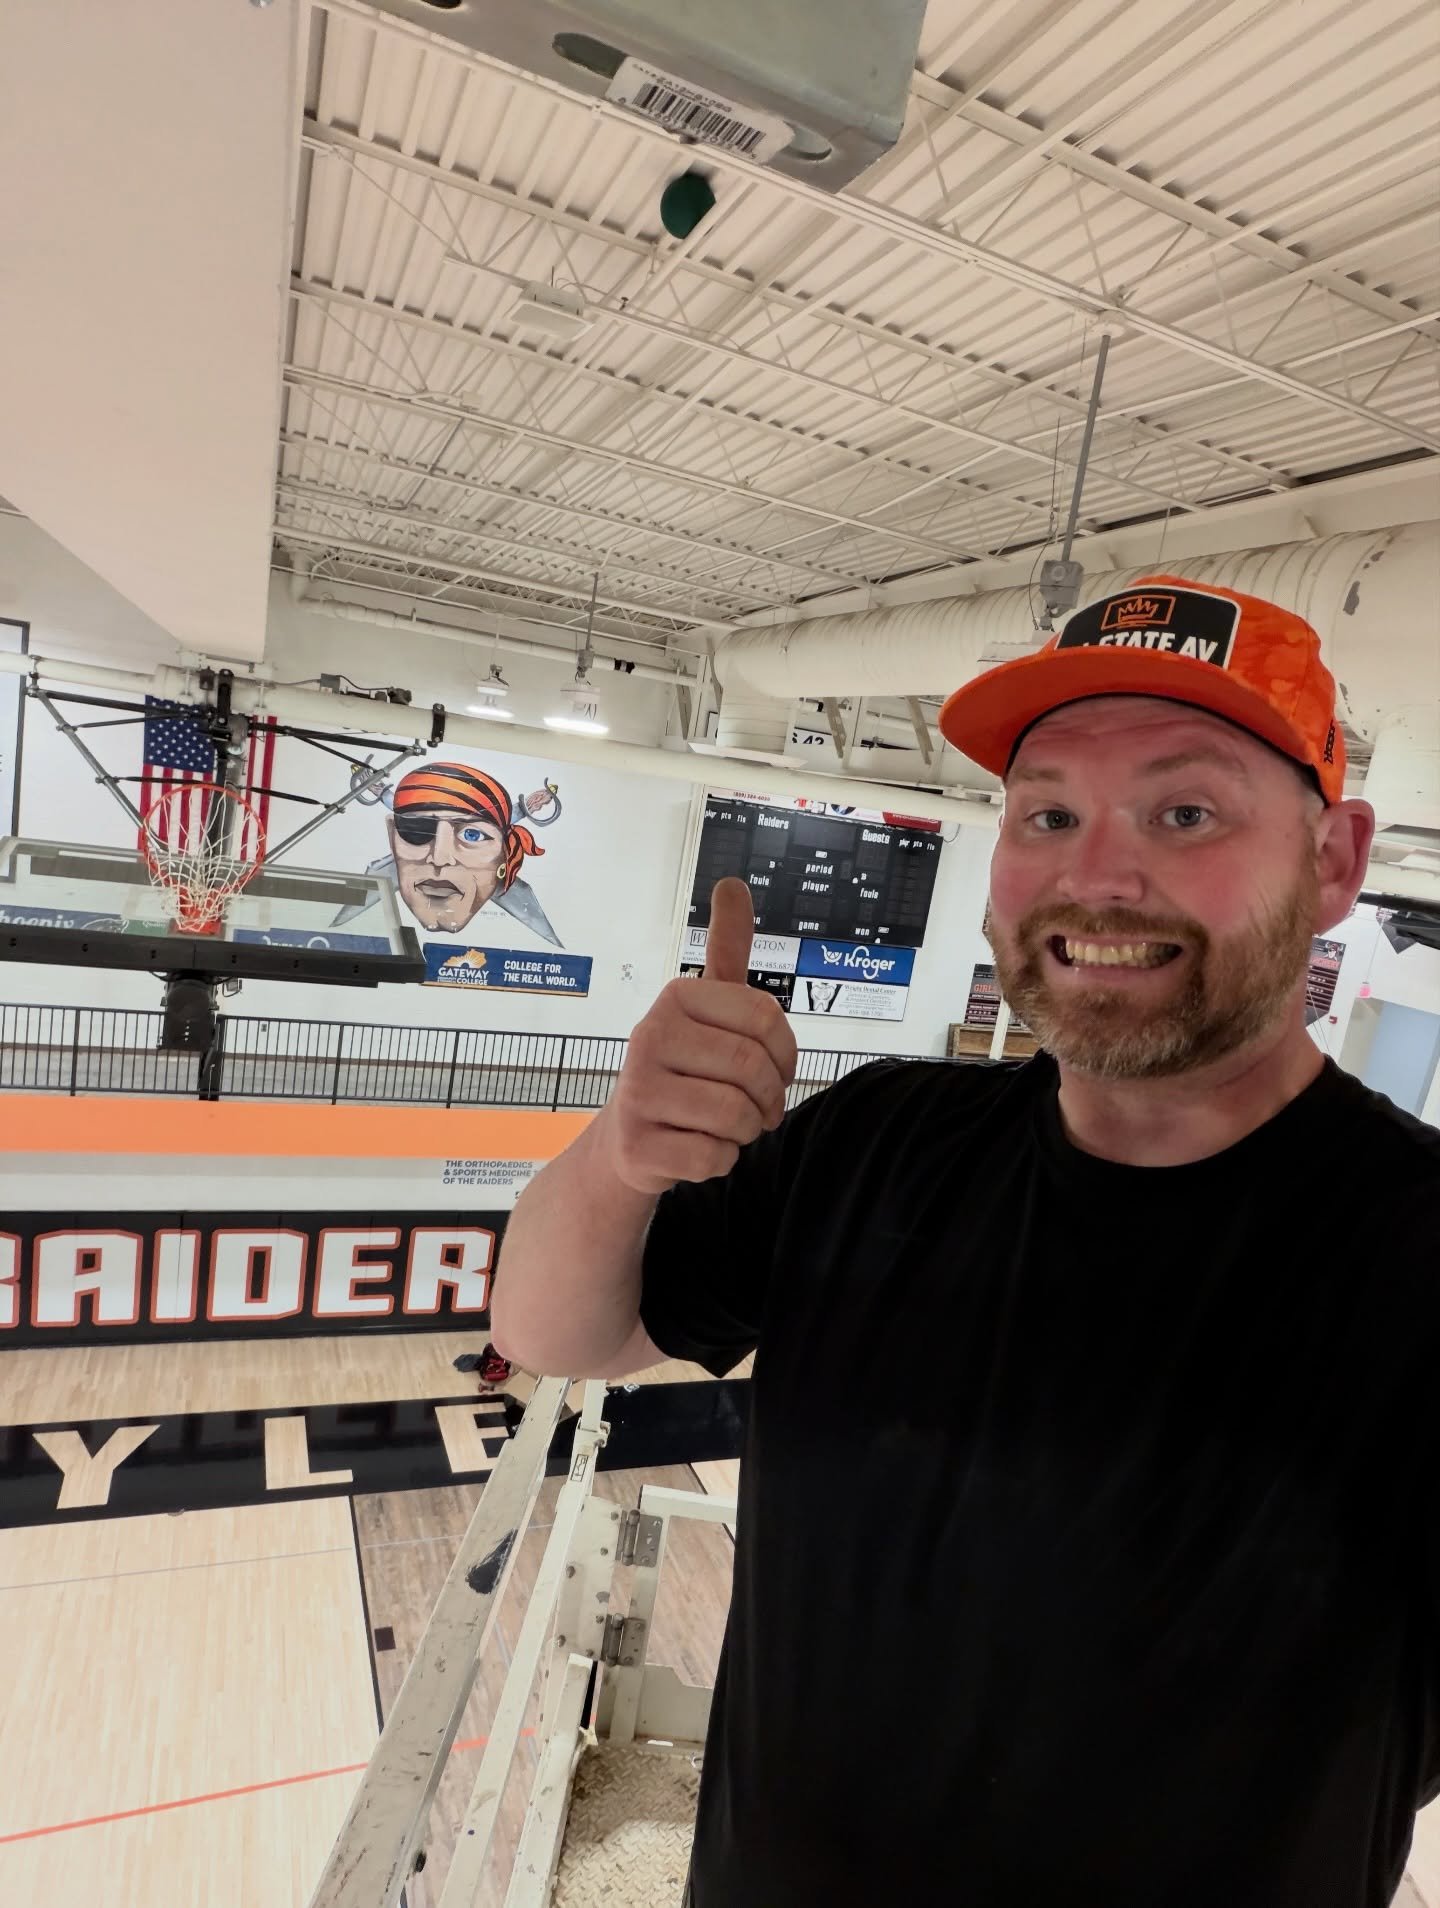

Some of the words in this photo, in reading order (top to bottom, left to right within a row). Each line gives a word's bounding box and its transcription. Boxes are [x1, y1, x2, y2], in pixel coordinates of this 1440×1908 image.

[720, 811, 732, 820] pts
[736, 814, 747, 823] fls
[757, 813, 790, 830] Raiders
[862, 829, 890, 844] Guests
[805, 863, 833, 875] period
[750, 874, 770, 886] fouls
[802, 881, 830, 893] player
[860, 888, 879, 899] fouls
[798, 921, 820, 931] game
[855, 927, 870, 936] won
[504, 960, 544, 973] COLLEGE
[544, 964, 561, 974] FOR
[844, 945, 896, 980] Kroger
[438, 967, 490, 980] GATEWAY
[503, 972, 520, 983] THE
[521, 975, 544, 984] REAL
[546, 976, 578, 987] WORLD.
[456, 977, 488, 986] COLLEGE
[446, 1160, 463, 1168] THE
[465, 1160, 533, 1169] ORTHOPAEDICS
[443, 1177, 455, 1185] OF
[0, 1227, 496, 1329] AIDER
